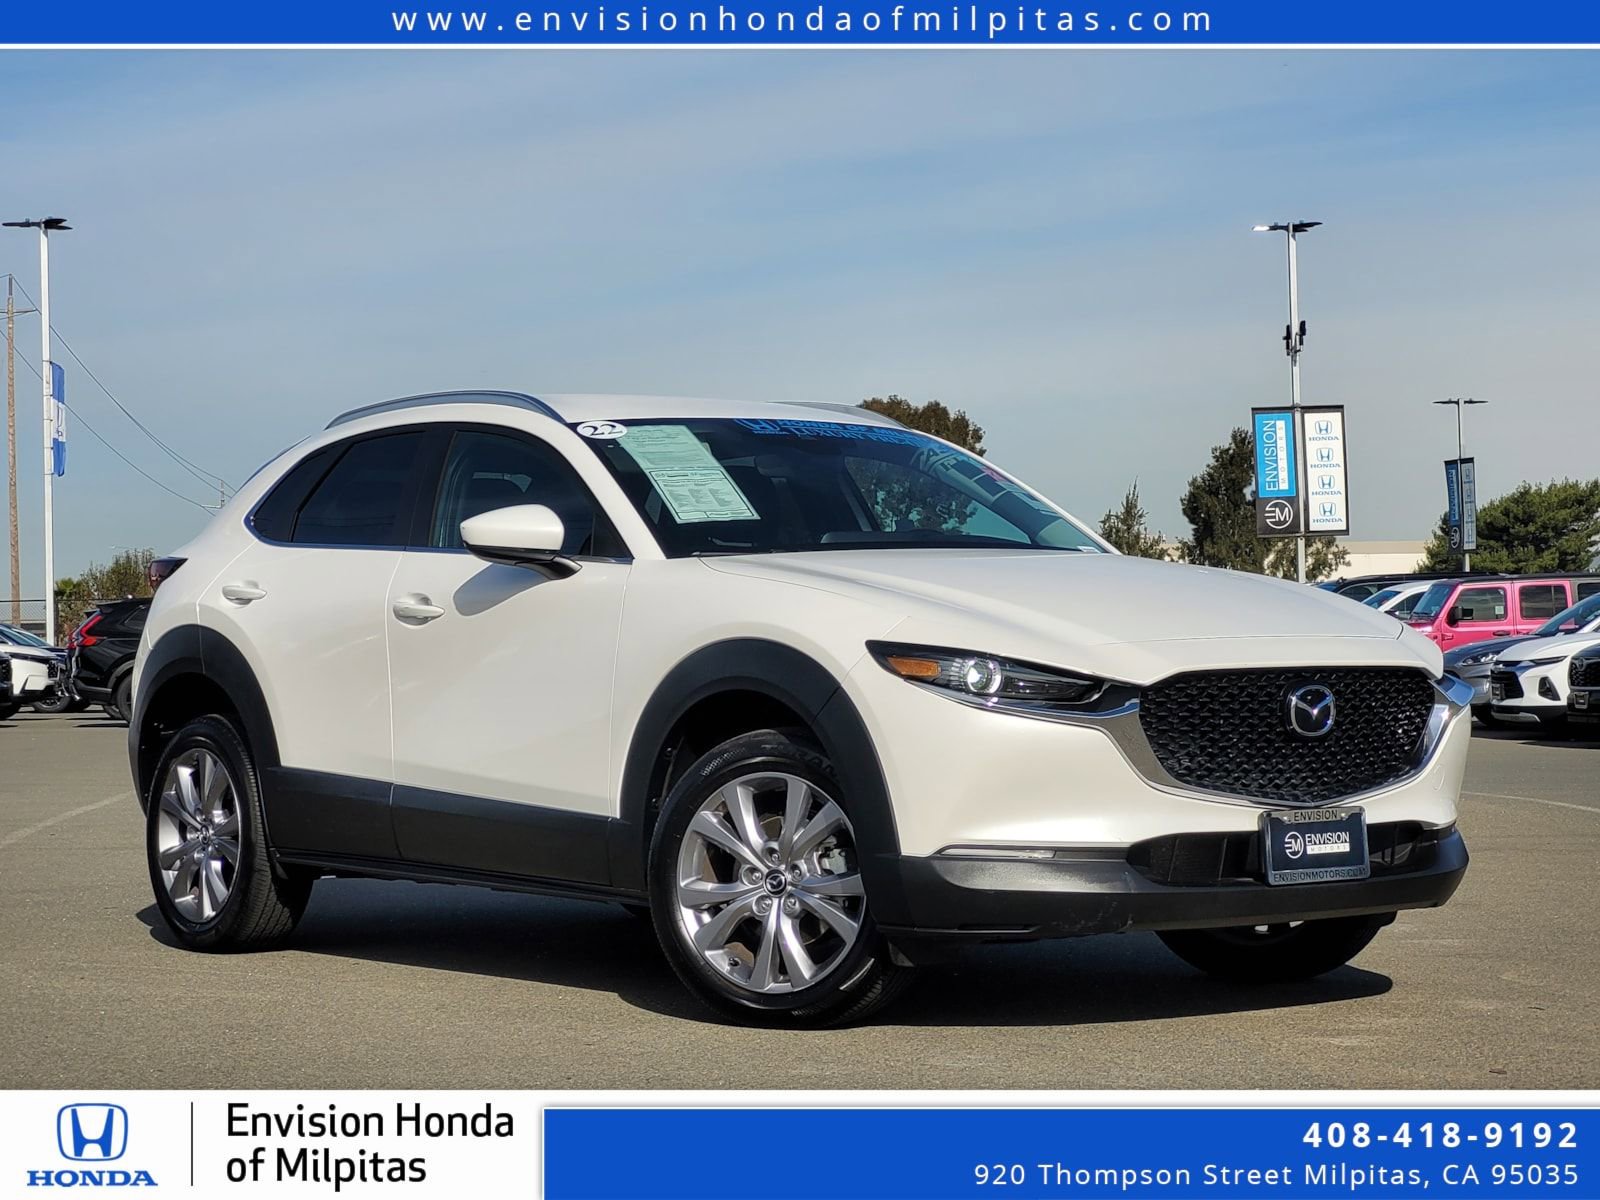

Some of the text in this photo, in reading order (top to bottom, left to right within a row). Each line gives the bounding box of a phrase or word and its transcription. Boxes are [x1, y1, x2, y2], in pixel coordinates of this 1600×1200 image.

[582, 423, 623, 436] 22
[1263, 420, 1278, 490] ENVISION
[1293, 809, 1338, 822] ENVISION
[1305, 831, 1349, 845] ENVISION
